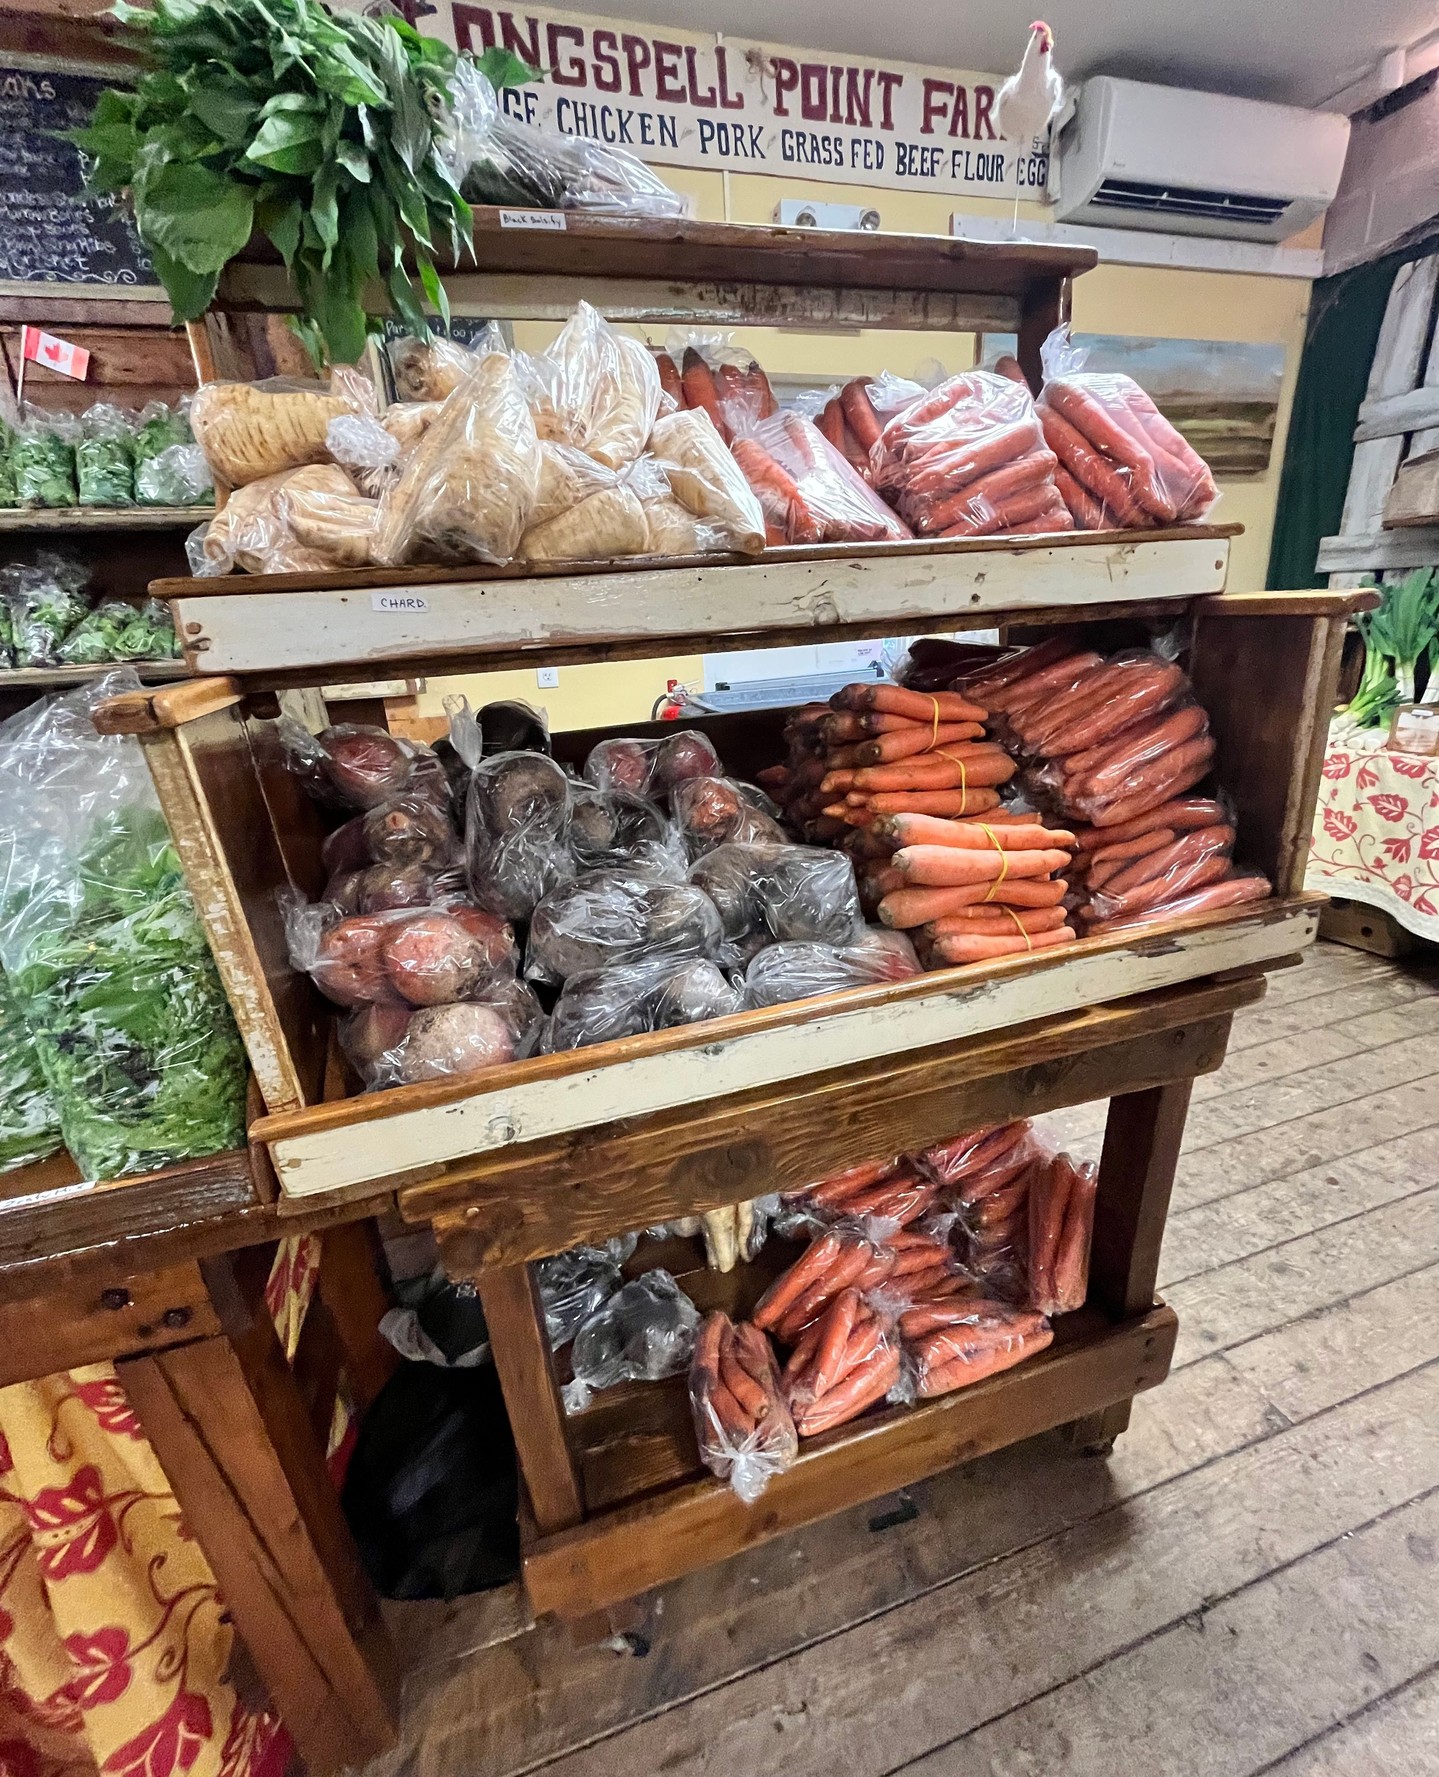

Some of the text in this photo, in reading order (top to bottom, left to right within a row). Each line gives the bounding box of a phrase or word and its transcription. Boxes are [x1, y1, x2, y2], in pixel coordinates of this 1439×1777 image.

[391, 0, 1007, 142] ONGSPELL POINT FAR
[556, 97, 679, 148] CHICKEN
[696, 118, 767, 160] PORK
[780, 128, 844, 167] GRASS
[850, 138, 885, 170] FED
[895, 141, 944, 178] BEEF
[950, 149, 1005, 183] FLOUR
[502, 213, 528, 224] Black
